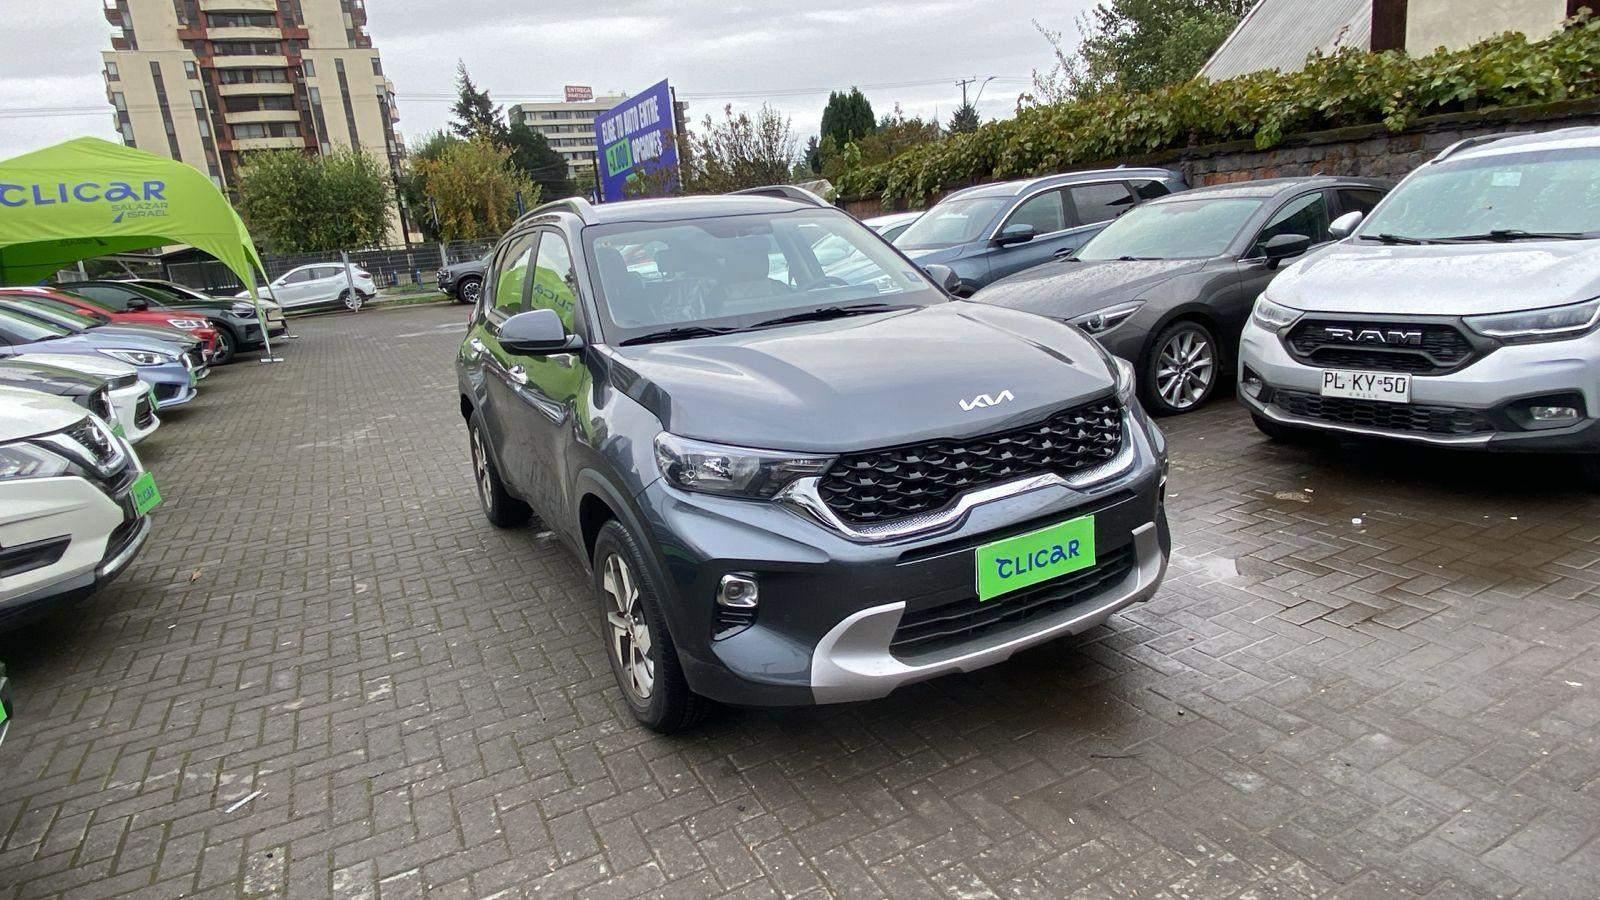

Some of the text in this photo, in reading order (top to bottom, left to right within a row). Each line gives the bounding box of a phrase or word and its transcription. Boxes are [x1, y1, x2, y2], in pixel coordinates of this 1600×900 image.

[112, 203, 169, 211] SALAZAR
[127, 210, 169, 218] ISRAEL
[1325, 328, 1421, 344] RAM
